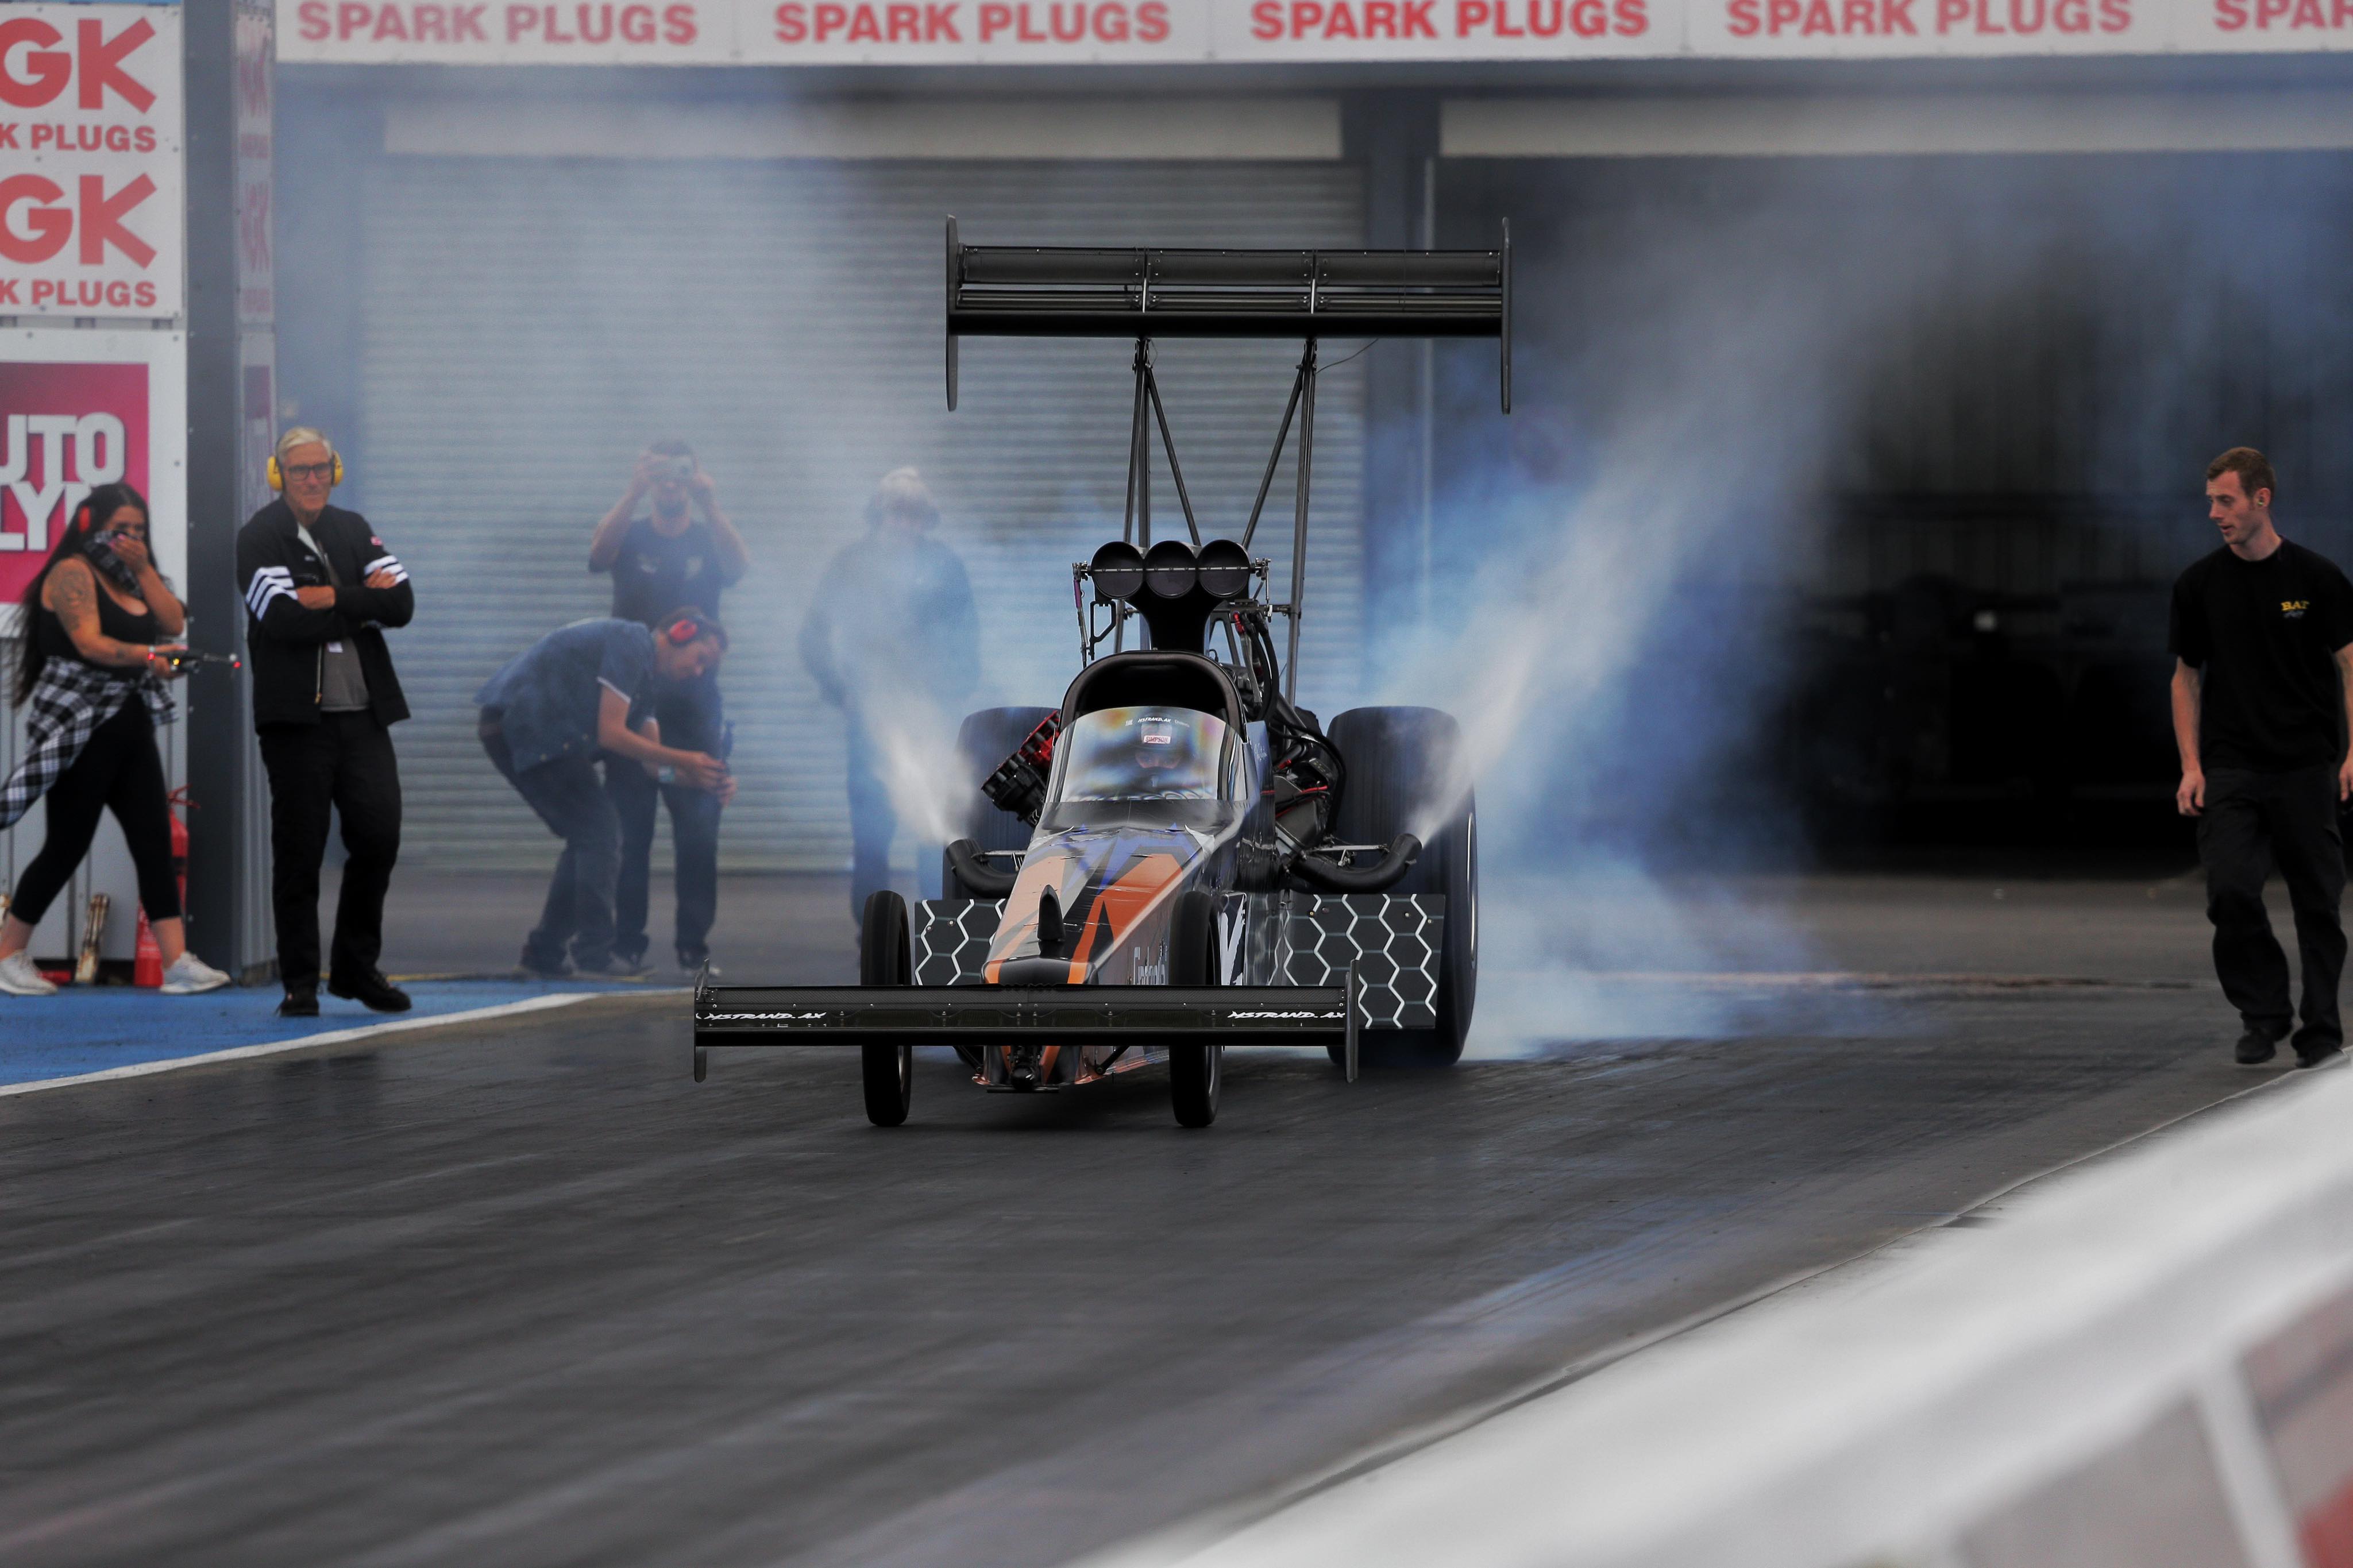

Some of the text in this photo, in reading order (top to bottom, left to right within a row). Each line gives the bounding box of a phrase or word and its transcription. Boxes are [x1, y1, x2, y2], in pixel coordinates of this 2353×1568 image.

[299, 1, 699, 45] SPARK PLUGS
[774, 1, 1171, 44] SPARK PLUGS
[1251, 0, 1650, 41] SPARK PLUGS
[1726, 0, 2132, 37] SPARK PLUGS
[0, 17, 156, 113] GK
[31, 124, 156, 153] PLUGS
[0, 173, 157, 269] GK
[32, 280, 157, 307] PLUGS
